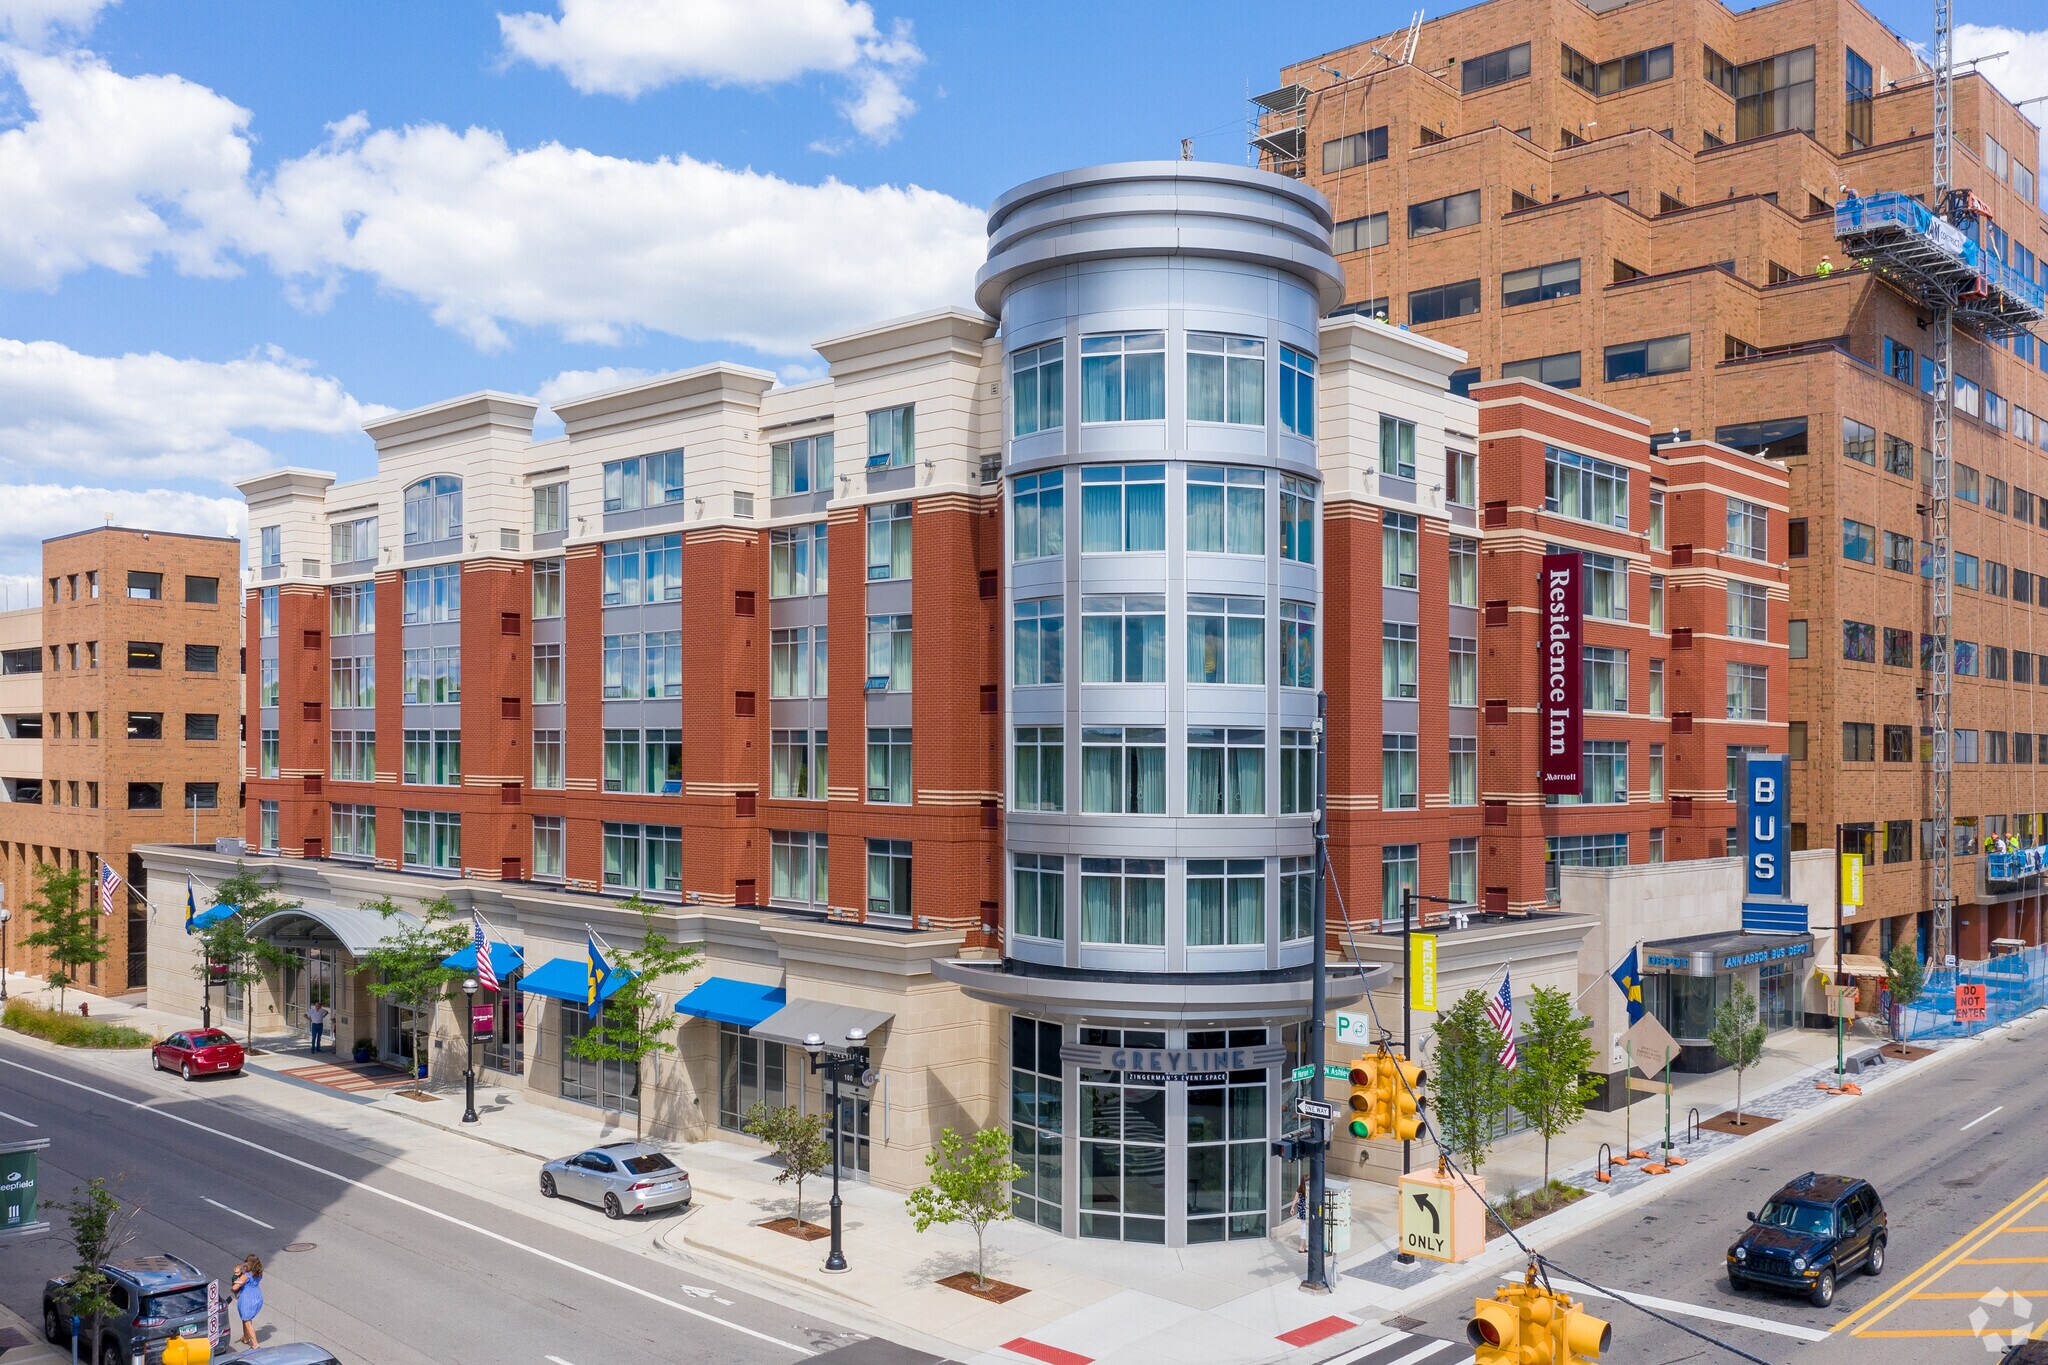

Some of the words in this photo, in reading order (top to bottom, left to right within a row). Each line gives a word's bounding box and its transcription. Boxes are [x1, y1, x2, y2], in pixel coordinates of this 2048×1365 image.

[1550, 568, 1570, 702] Residence
[1550, 708, 1570, 756] Inn
[1545, 773, 1576, 781] Marriott
[1754, 777, 1775, 879] BUS
[1648, 955, 1689, 969] DEPOT
[1725, 955, 1742, 968] ANN
[1744, 951, 1768, 965] ARBOR
[1771, 947, 1786, 959] BUS
[1787, 943, 1809, 956] DEPOT
[1963, 986, 1977, 995] DO
[1961, 997, 1980, 1006] NOT
[1956, 1008, 1986, 1018] ENTER
[1338, 1016, 1350, 1037] P
[1111, 1050, 1246, 1071] GREYLINE
[1129, 1073, 1178, 1081] ZINGERMAN'S
[1305, 1104, 1316, 1112] ONE
[0, 1179, 34, 1191] eepfield
[1408, 1233, 1444, 1252] ONLY
